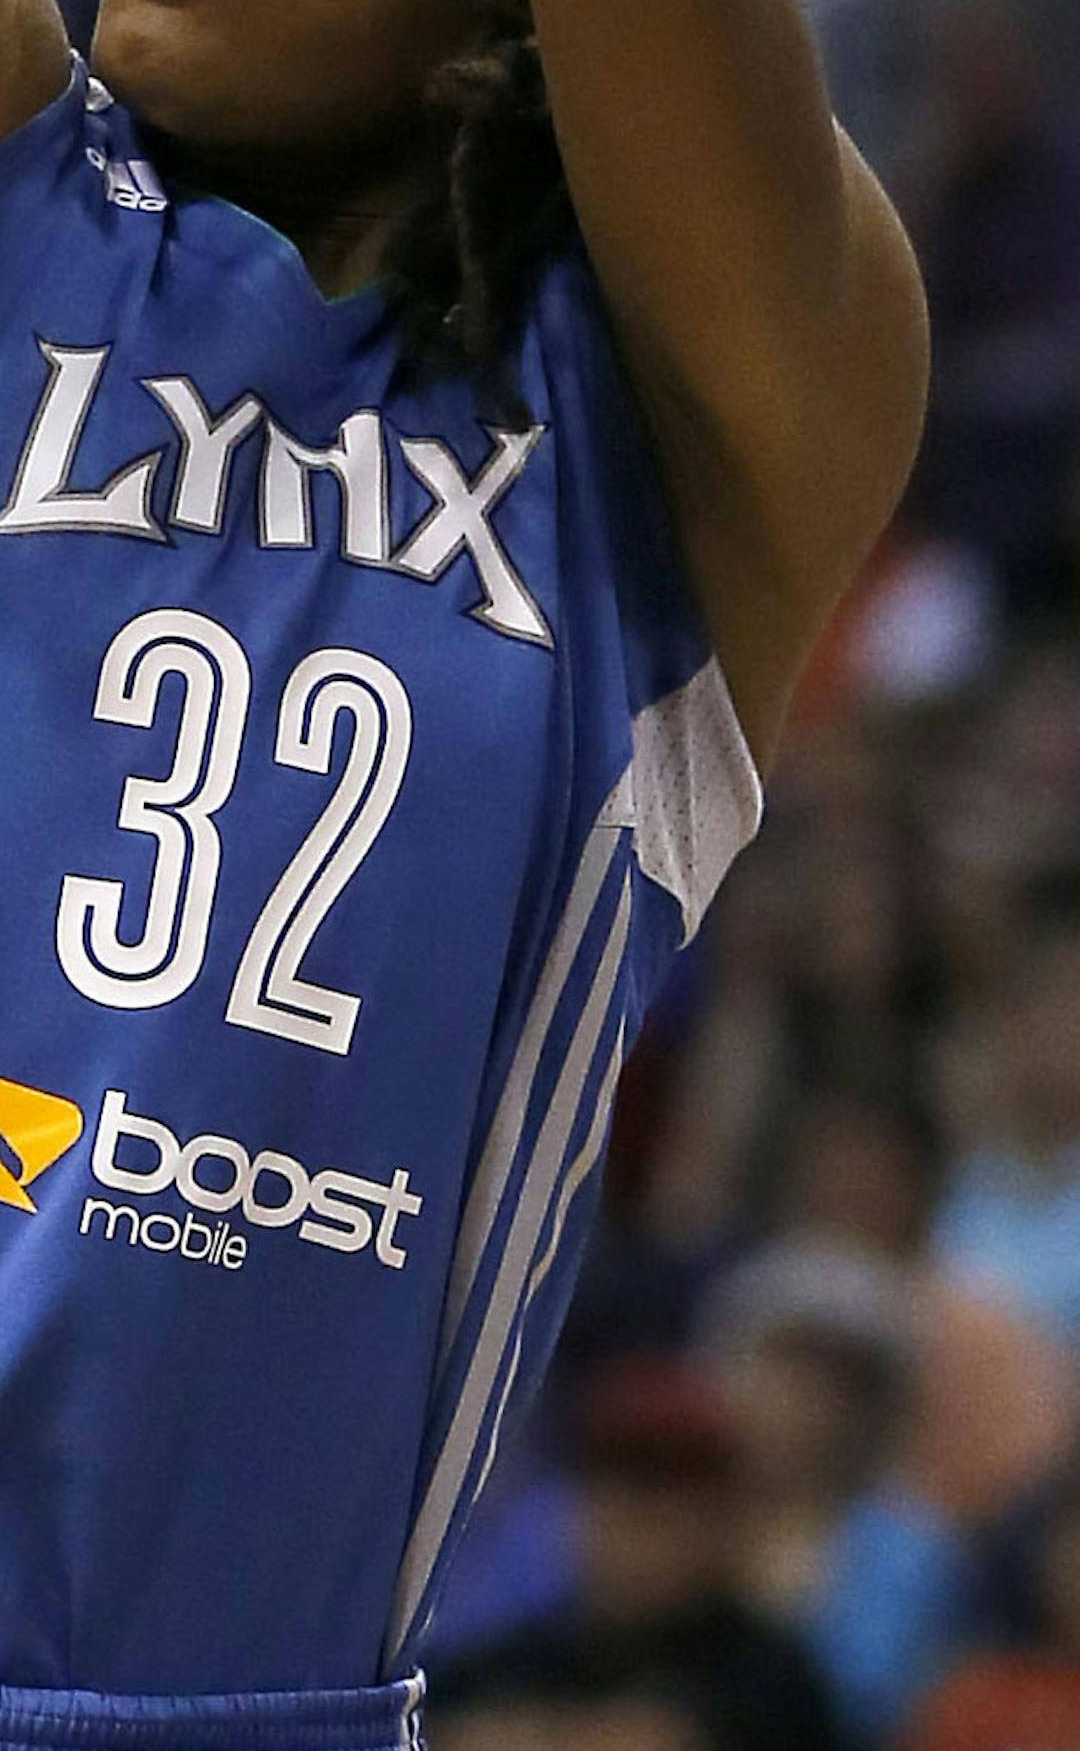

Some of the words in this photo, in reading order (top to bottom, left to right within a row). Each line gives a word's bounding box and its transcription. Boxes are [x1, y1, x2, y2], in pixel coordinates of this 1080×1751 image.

[56, 607, 414, 1056] 32
[79, 1197, 248, 1272] mobile
[91, 1088, 423, 1269] boost
